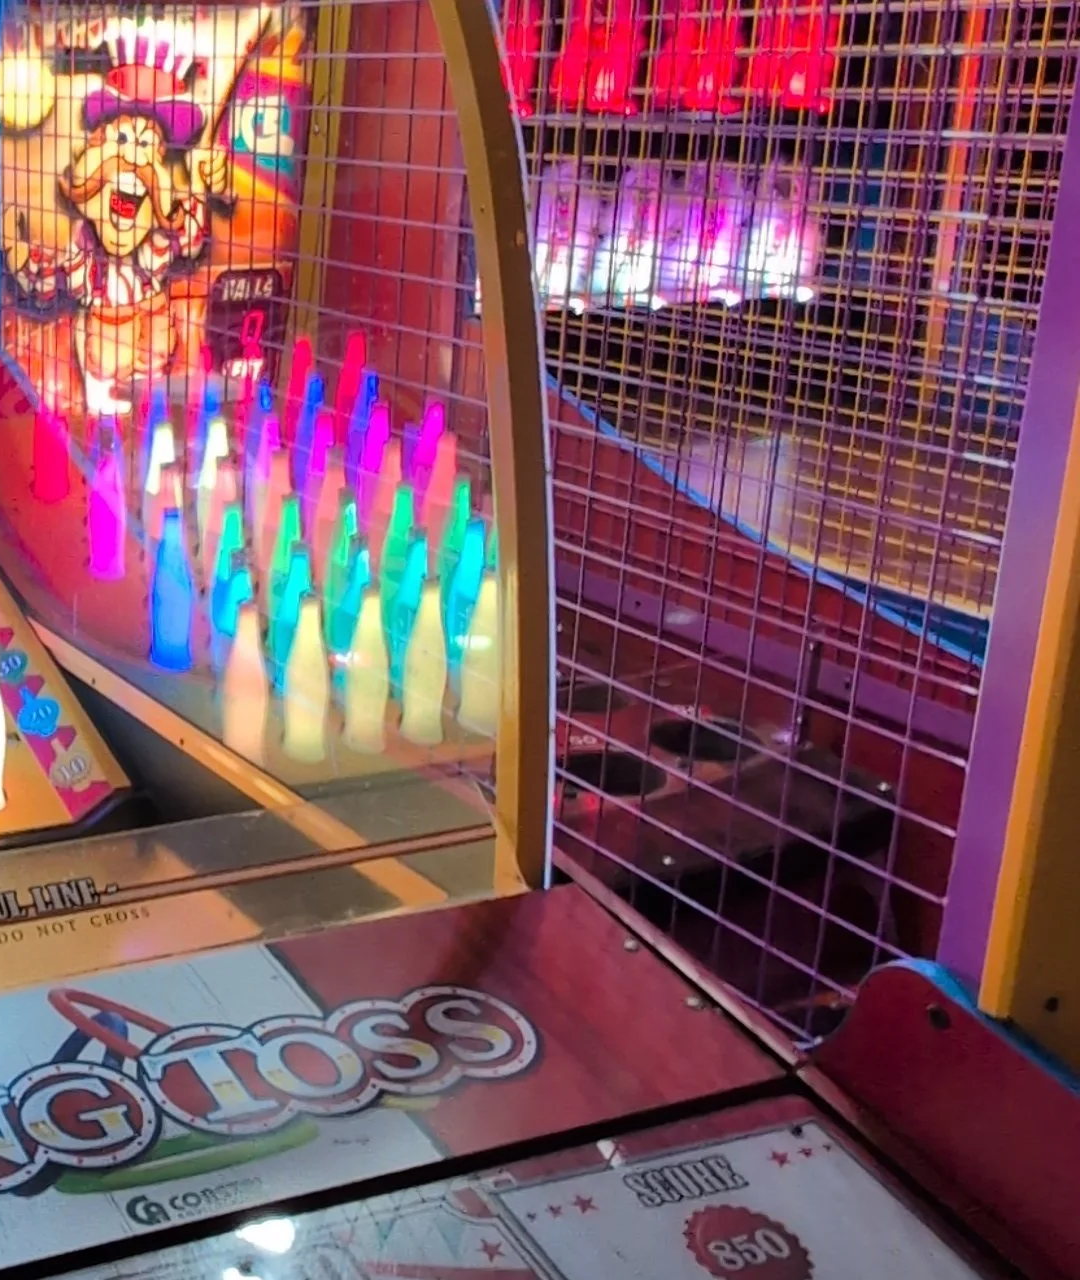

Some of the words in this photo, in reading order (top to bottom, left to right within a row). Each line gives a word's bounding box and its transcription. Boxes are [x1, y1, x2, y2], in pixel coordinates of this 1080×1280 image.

[60, 757, 86, 783] 10
[30, 876, 101, 914] LINE
[38, 919, 78, 938] NOT
[89, 905, 152, 928] CROSS
[148, 998, 517, 1123] TOSS
[622, 1155, 749, 1207] SCORE
[707, 1227, 792, 1272] 850
